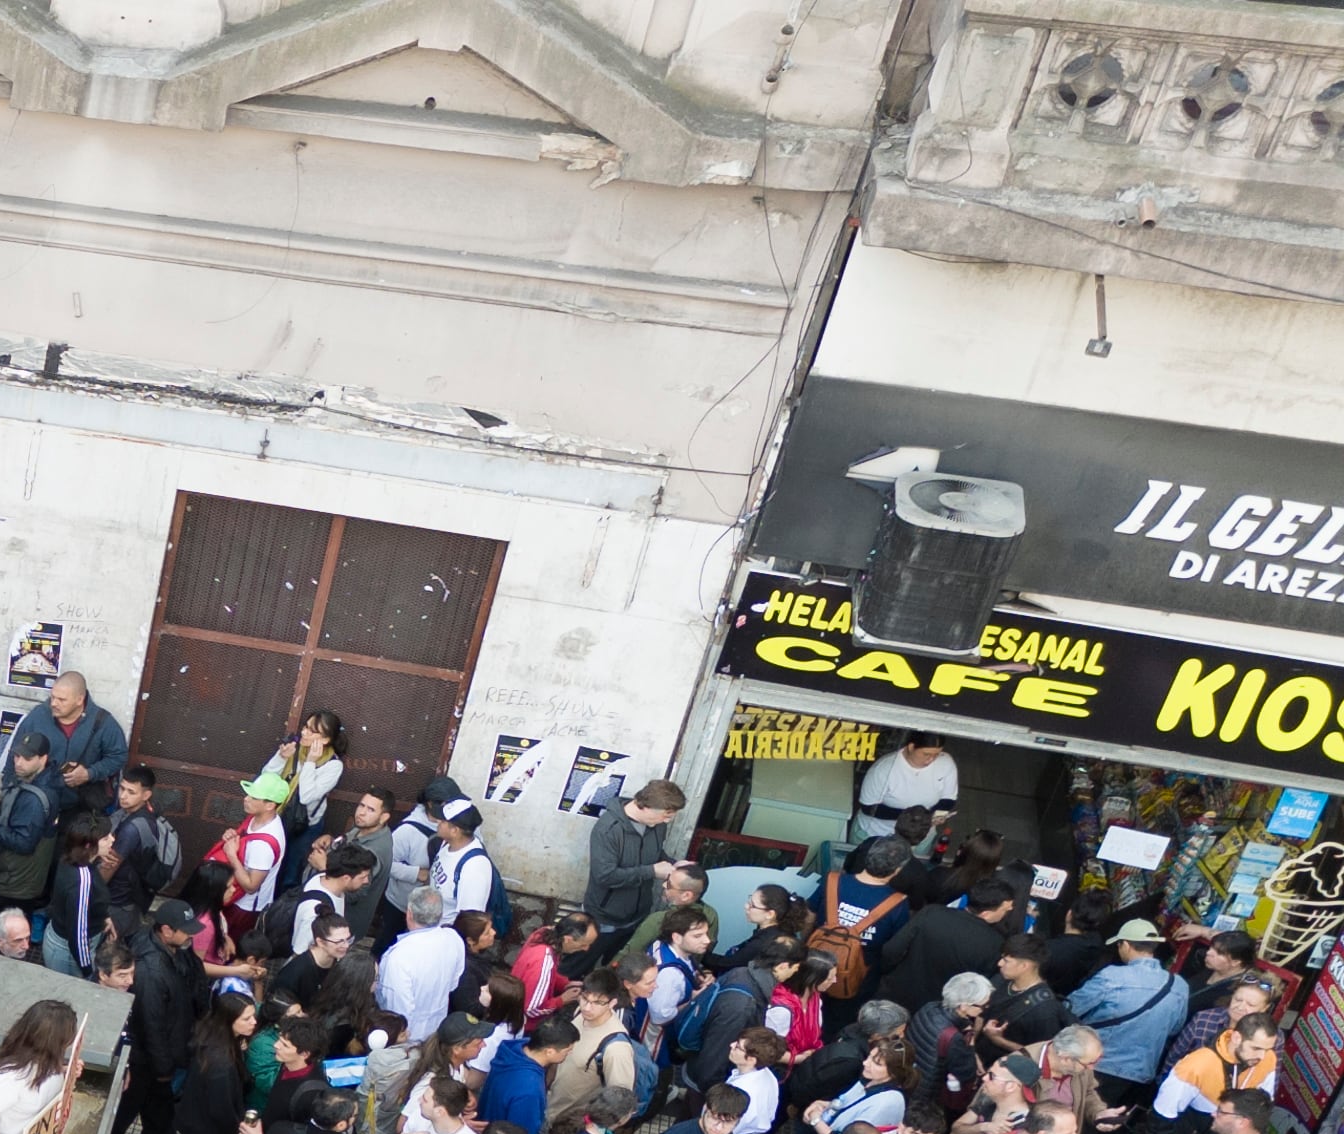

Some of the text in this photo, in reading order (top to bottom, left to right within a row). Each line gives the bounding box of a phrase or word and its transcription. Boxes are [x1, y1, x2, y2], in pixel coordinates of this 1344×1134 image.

[1114, 479, 1344, 564] IL GEL
[56, 602, 102, 621] SHOW
[1169, 550, 1344, 603] DI AREZ
[763, 590, 1105, 676] HELA ESANAL
[756, 636, 1098, 718] CAFE
